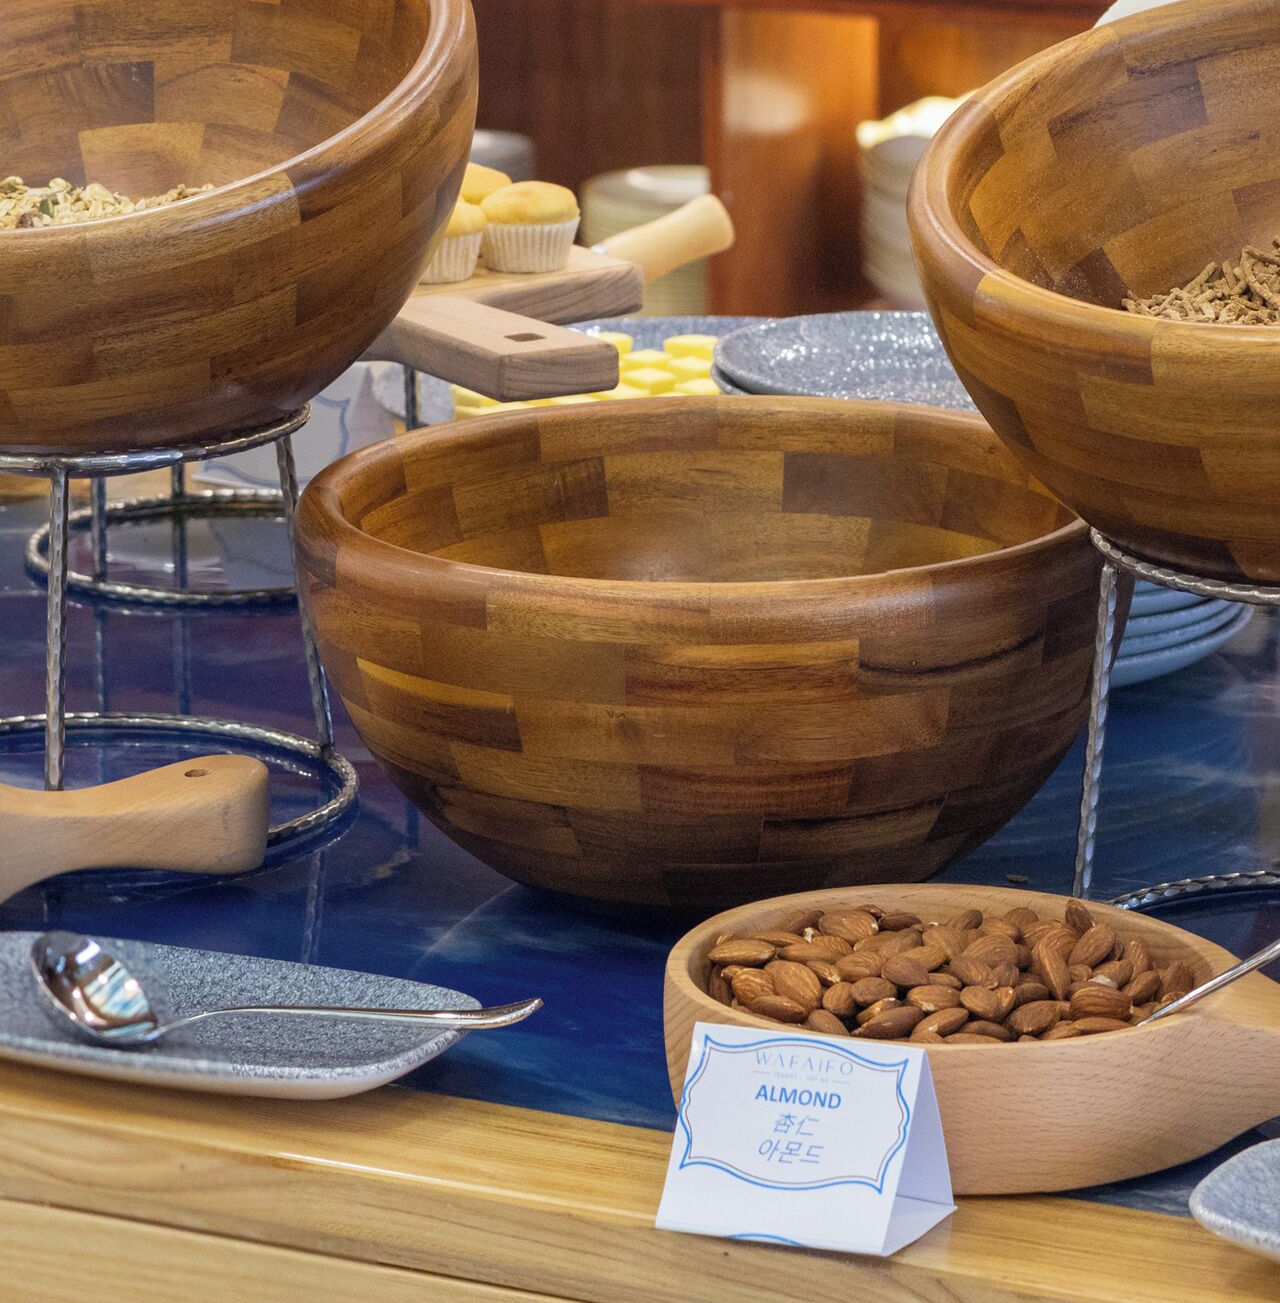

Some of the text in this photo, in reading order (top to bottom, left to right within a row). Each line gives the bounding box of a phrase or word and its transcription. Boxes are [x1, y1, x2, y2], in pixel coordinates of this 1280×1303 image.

[755, 1049, 854, 1076] WAFAIFO
[754, 1083, 842, 1109] ALMOND
[773, 1112, 820, 1136] 杏仁
[758, 1139, 824, 1164] 아몬드
